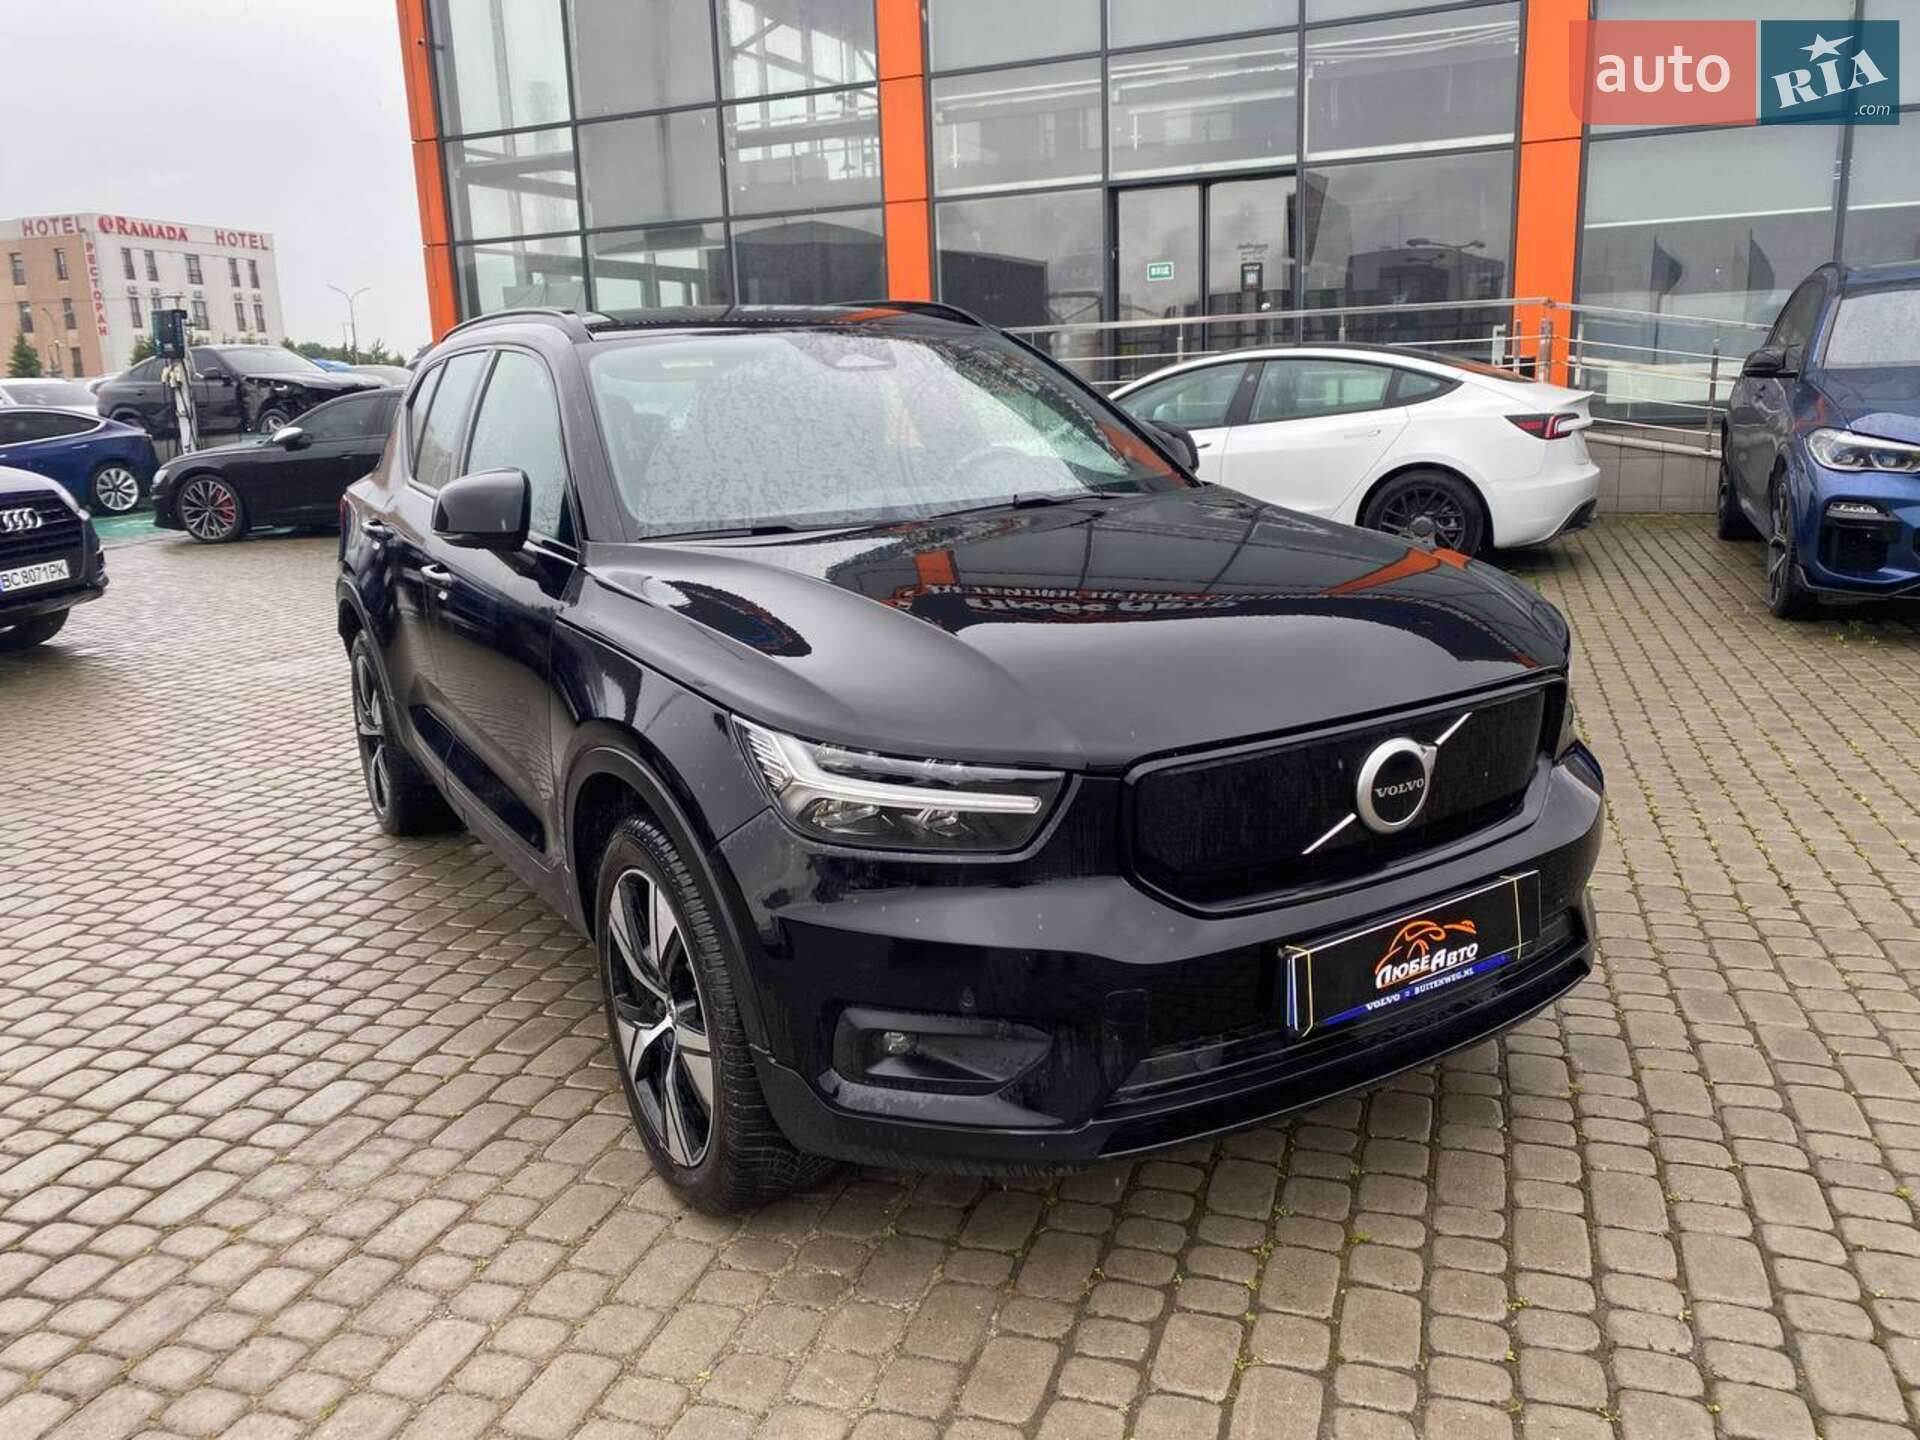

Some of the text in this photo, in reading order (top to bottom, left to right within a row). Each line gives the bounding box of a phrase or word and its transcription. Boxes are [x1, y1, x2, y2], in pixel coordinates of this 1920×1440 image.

[22, 215, 86, 237] HOTEL
[214, 230, 269, 250] HOTEL
[1375, 778, 1424, 798] VOLVO
[1365, 993, 1400, 1011] VOLVO
